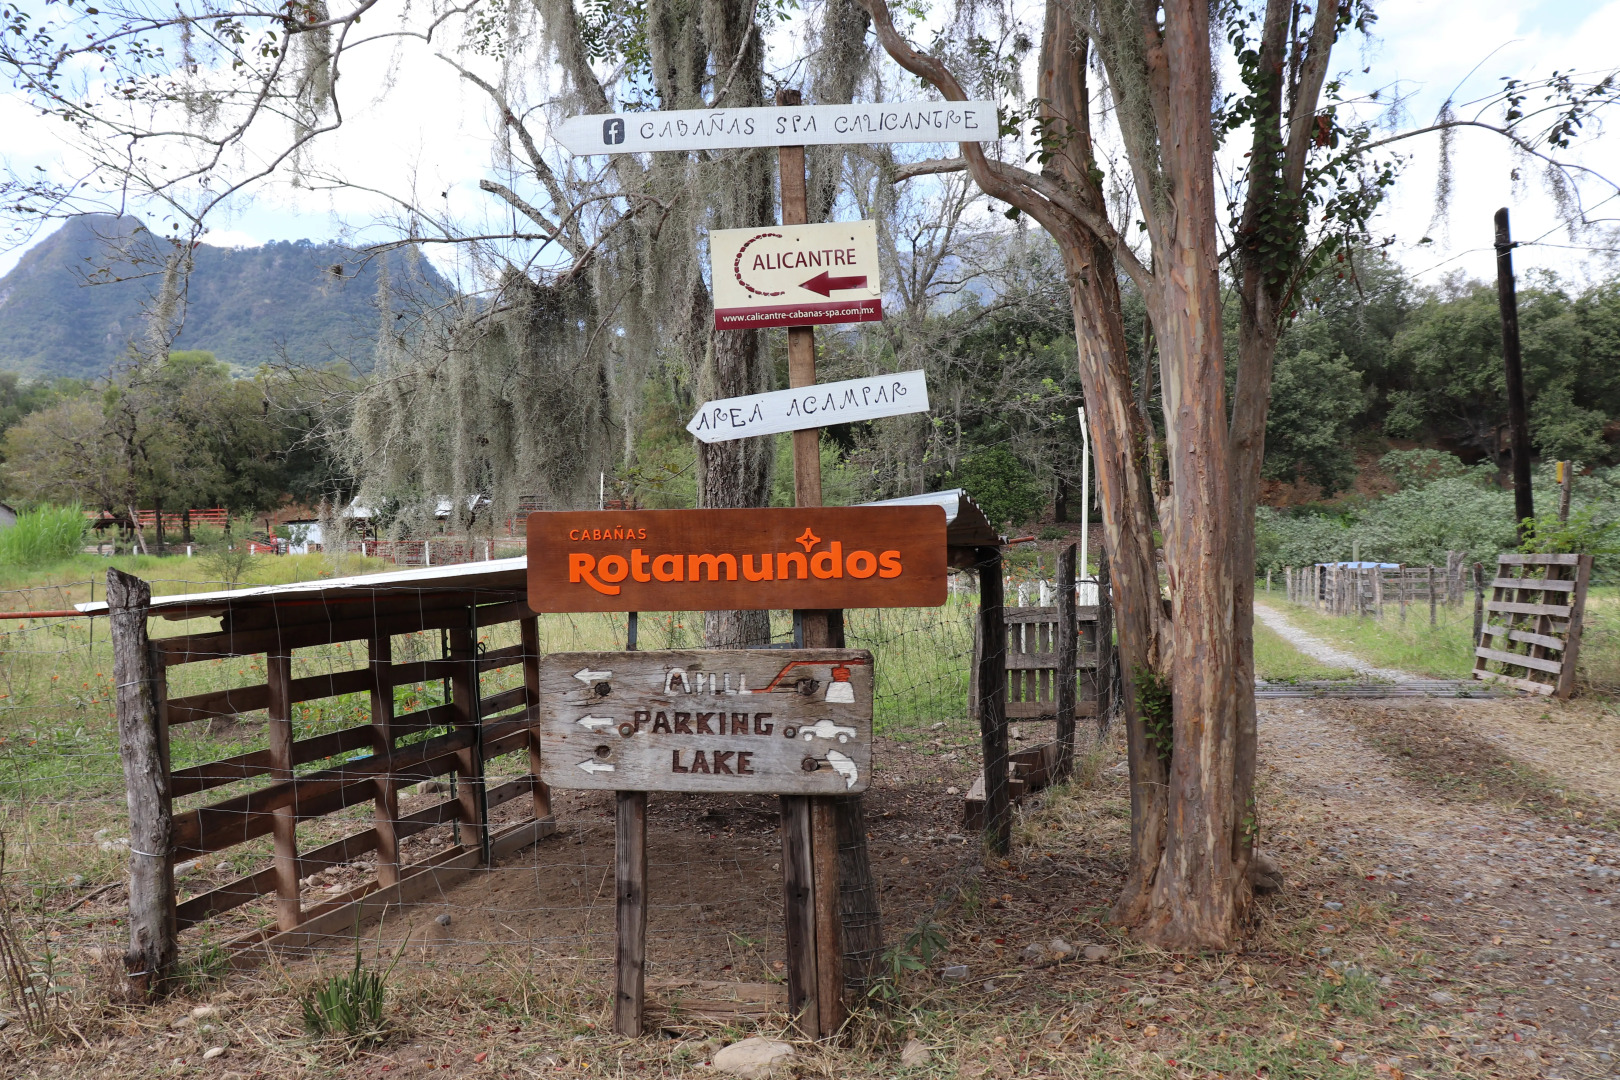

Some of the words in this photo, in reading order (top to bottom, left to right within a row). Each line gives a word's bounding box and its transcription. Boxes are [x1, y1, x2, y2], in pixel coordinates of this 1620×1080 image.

[640, 112, 755, 139] CABAÑAS
[775, 115, 817, 134] SPA
[834, 110, 979, 134] CALICANTRE
[722, 306, 875, 323] www.calicantre-cabanas-spa.com.mx
[696, 403, 763, 431] AREA
[786, 381, 907, 417] ACAMPAR
[569, 525, 647, 541] CABAÑAS
[568, 540, 903, 596] Rotamundos
[633, 710, 774, 736] PARKING
[671, 749, 754, 775] LAKE
